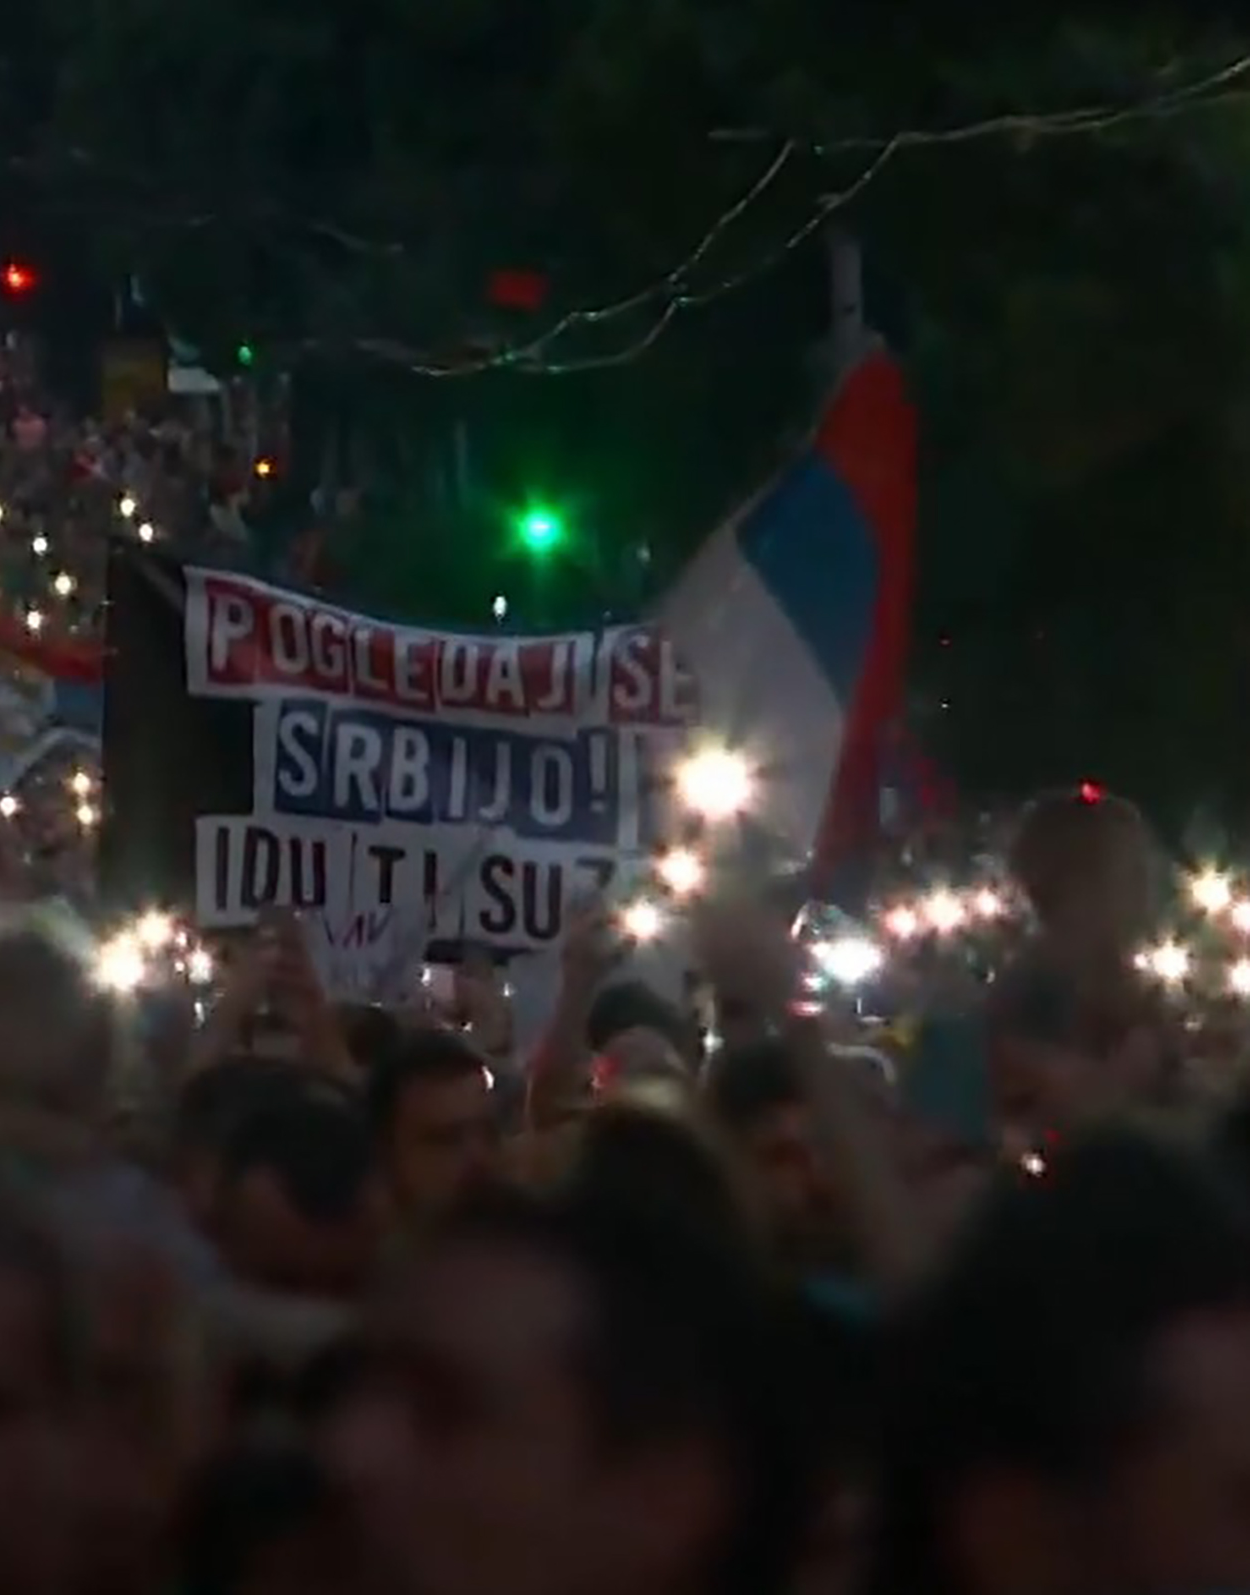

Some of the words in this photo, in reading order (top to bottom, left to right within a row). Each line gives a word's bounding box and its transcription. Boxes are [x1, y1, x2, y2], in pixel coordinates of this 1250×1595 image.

[209, 593, 572, 710] POGLEDAJ
[276, 710, 609, 827] SRBIJO!
[216, 827, 326, 910] IDU
